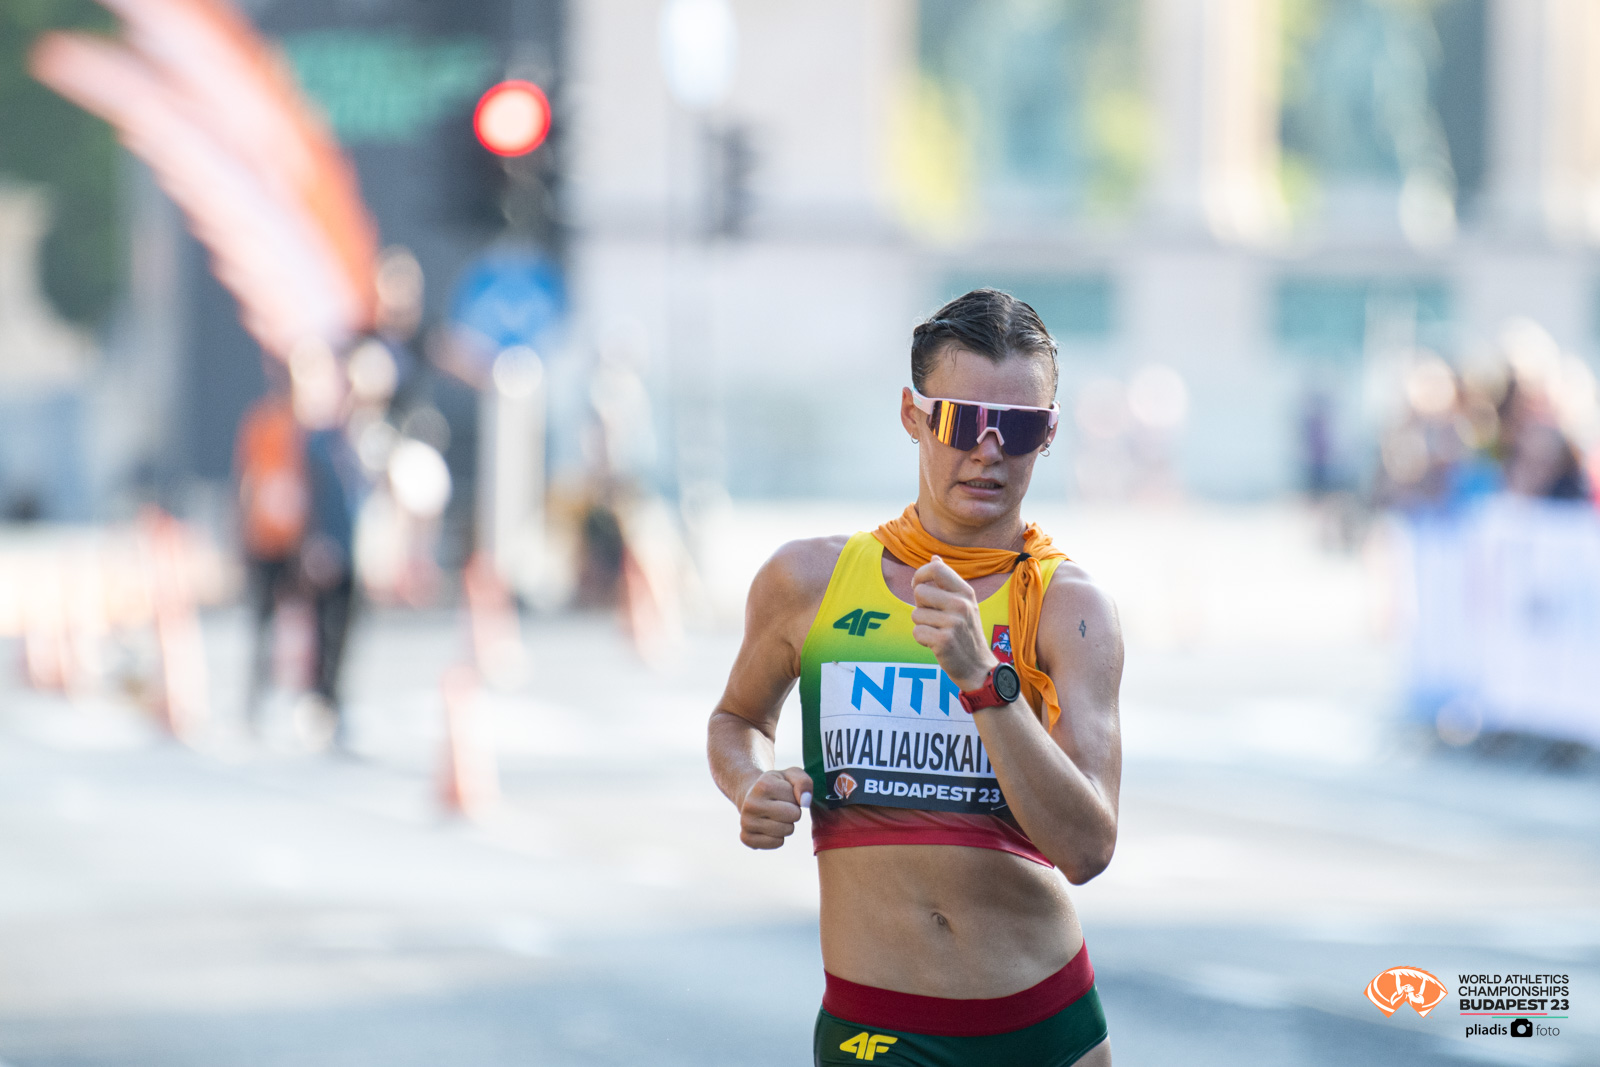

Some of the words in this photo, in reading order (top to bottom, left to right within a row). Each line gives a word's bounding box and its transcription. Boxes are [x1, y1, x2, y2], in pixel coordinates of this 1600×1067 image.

[832, 608, 891, 637] 4F
[864, 779, 976, 803] BUDAPEST
[978, 788, 1001, 804] 23
[839, 1032, 898, 1061] 4F
